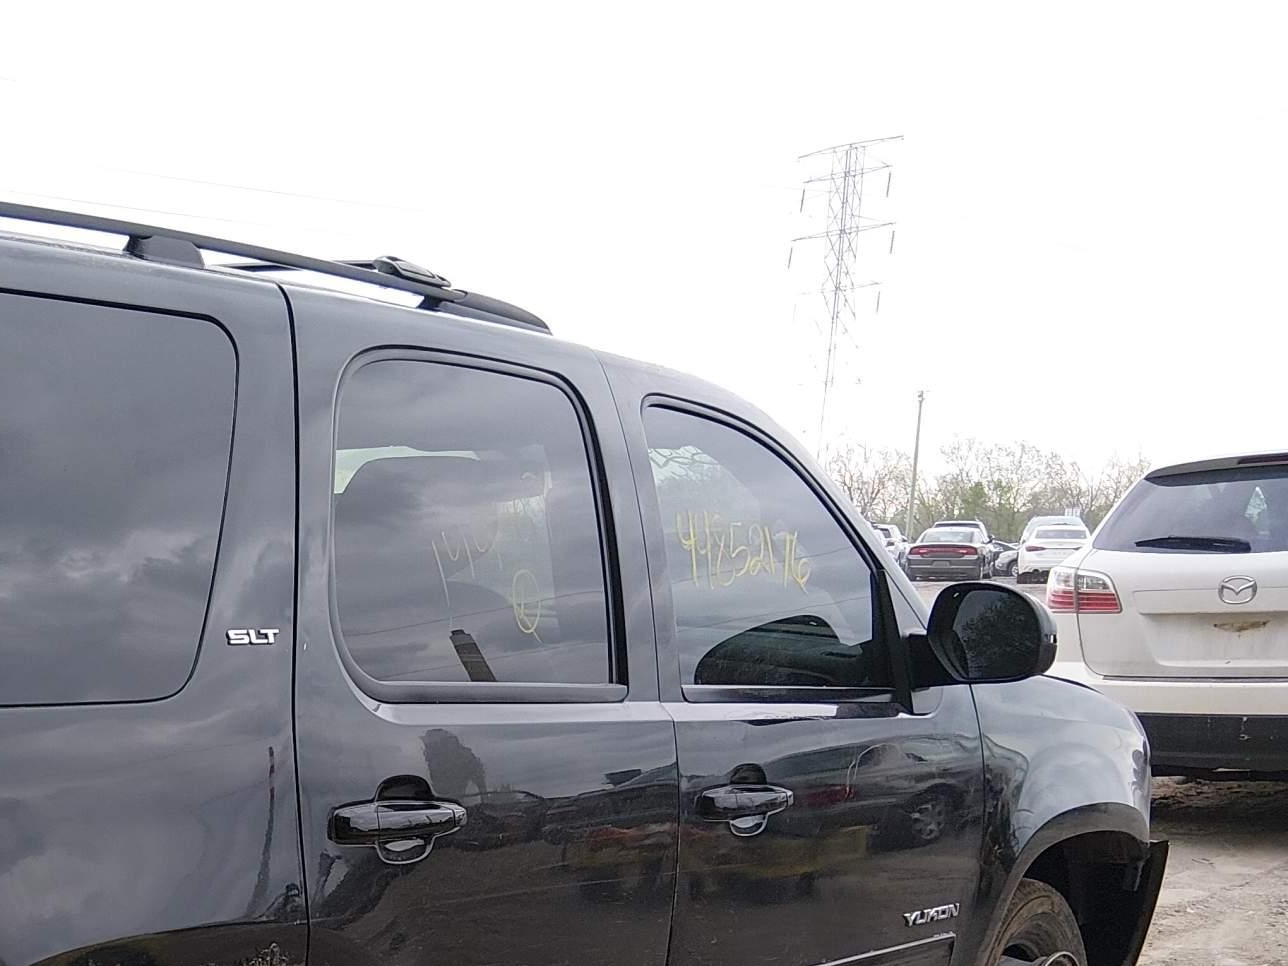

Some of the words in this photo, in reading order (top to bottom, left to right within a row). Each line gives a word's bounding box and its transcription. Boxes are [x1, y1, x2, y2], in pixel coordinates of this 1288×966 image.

[675, 508, 812, 595] 44852176
[226, 628, 280, 645] SLT
[903, 902, 961, 927] YUKON
